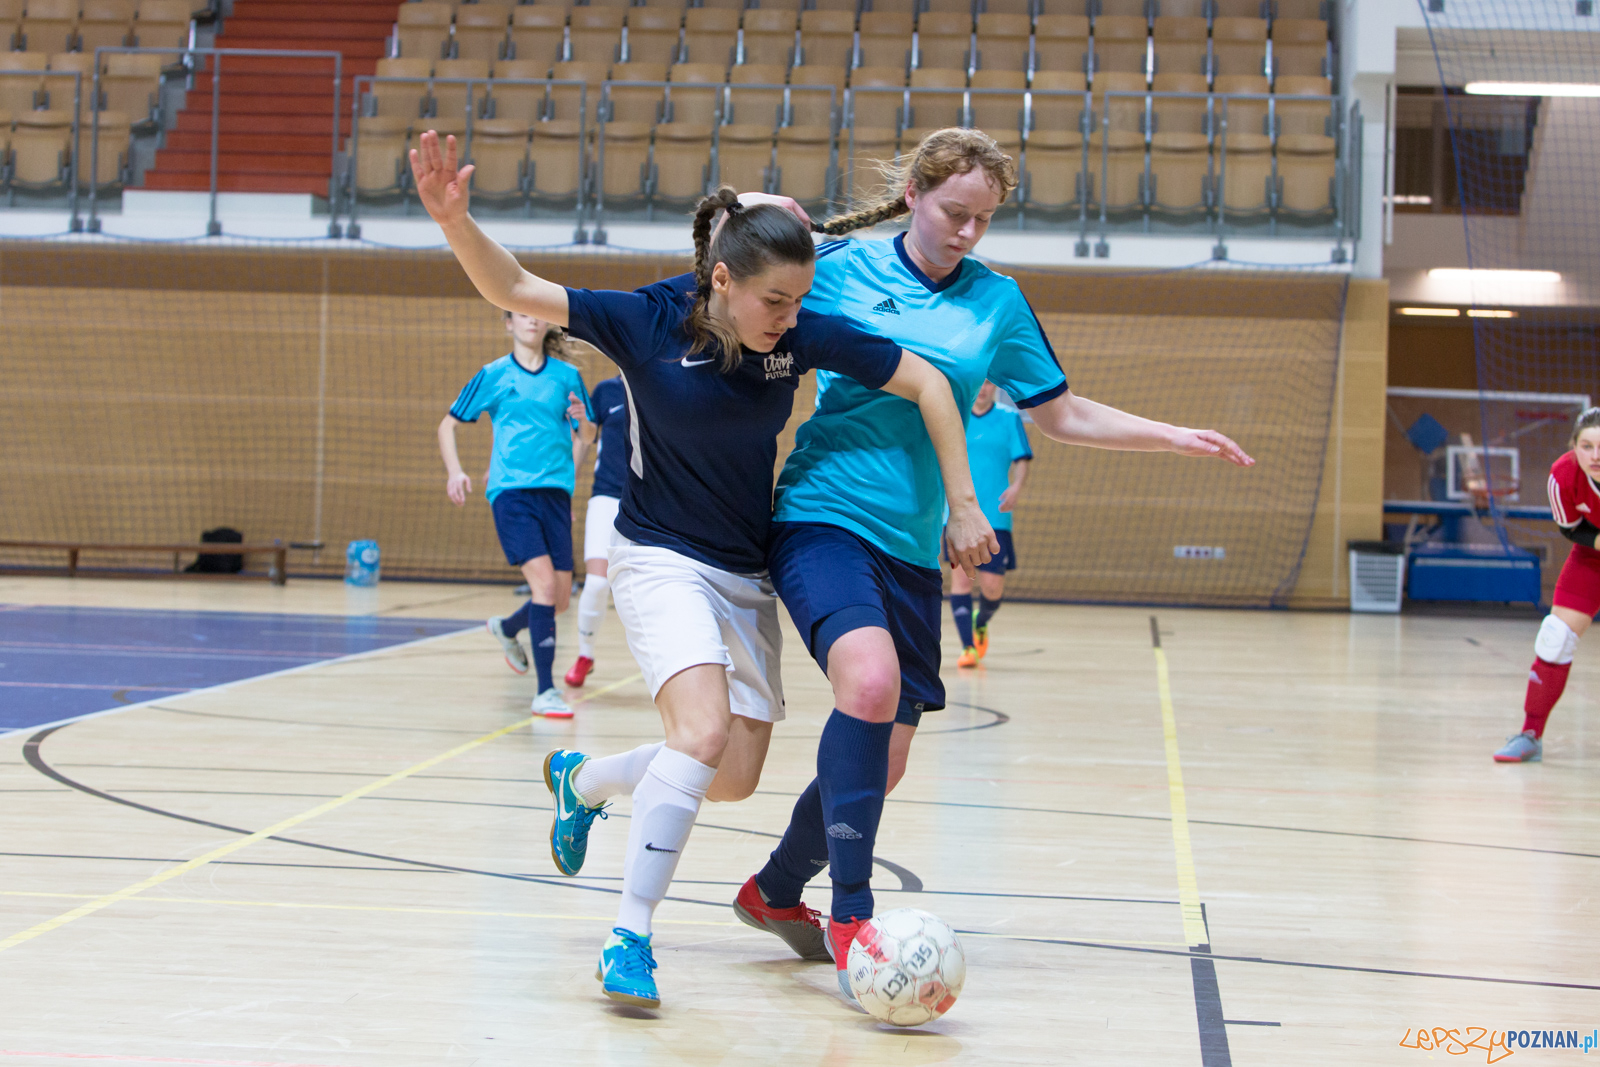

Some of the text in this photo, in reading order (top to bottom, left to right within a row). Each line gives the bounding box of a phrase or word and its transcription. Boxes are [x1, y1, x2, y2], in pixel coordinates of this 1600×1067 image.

[872, 306, 900, 315] adidas
[765, 369, 793, 380] FUTSAL
[882, 943, 933, 1001] SELECT
